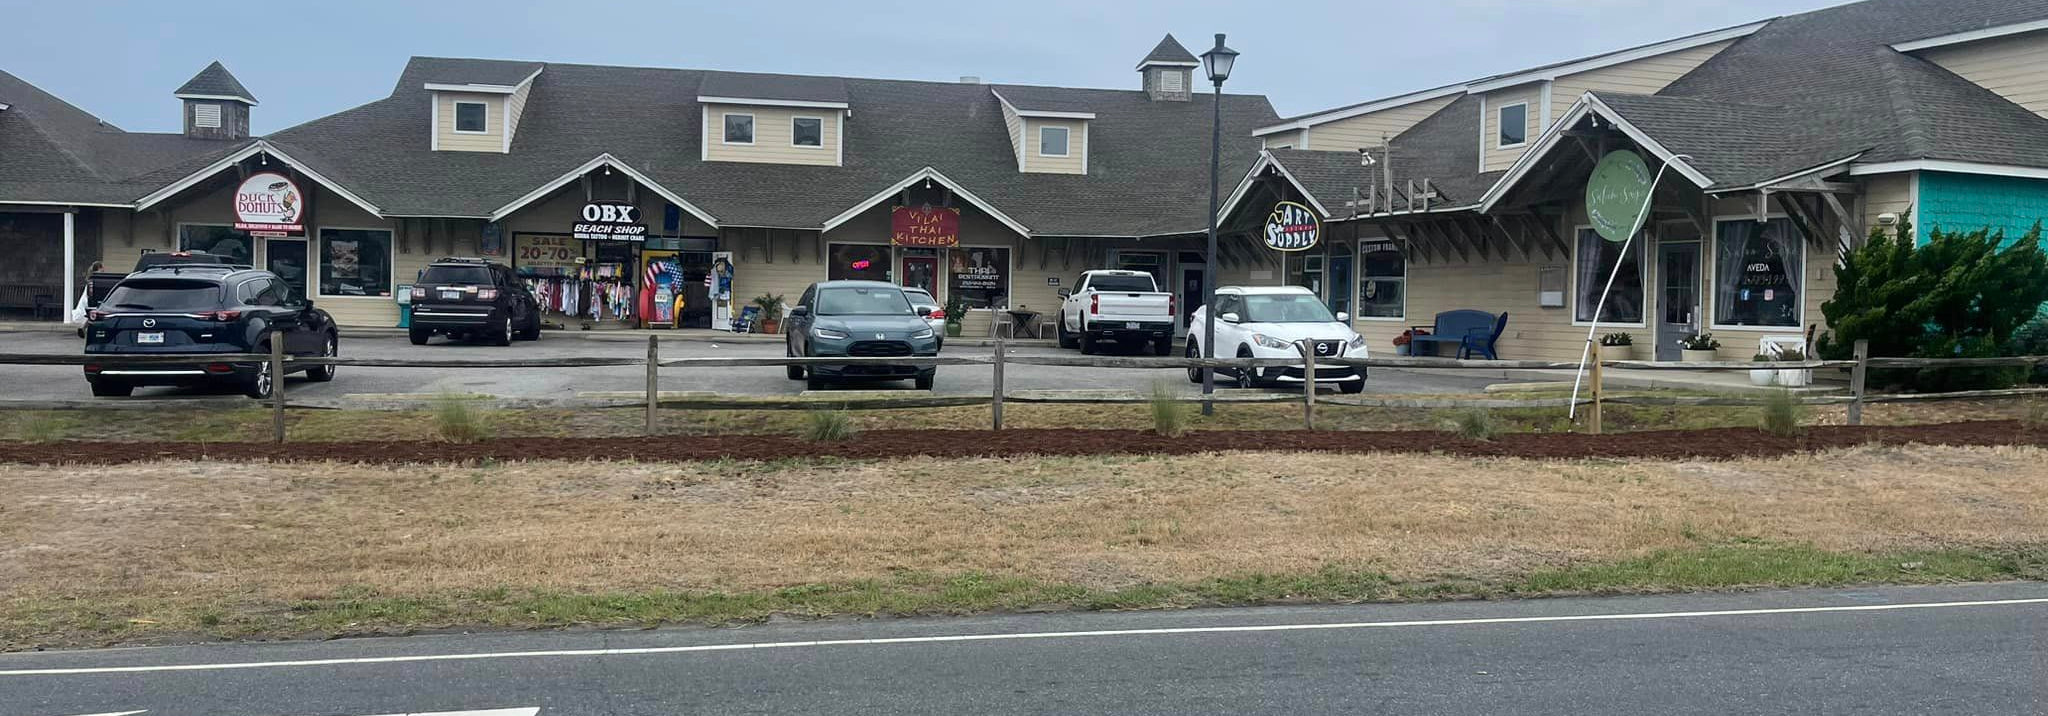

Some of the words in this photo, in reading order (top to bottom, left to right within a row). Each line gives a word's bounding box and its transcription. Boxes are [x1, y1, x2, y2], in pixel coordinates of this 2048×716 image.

[240, 193, 275, 203] DUCK
[239, 201, 283, 214] DONUTS
[583, 204, 634, 223] OBX
[909, 211, 943, 225] VILAI
[1283, 204, 1310, 225] ART
[574, 224, 613, 233] BEACH
[614, 226, 645, 235] SHOP
[909, 225, 941, 235] THAI
[1267, 222, 1316, 248] SUPPLY
[532, 237, 566, 246] SALE
[896, 232, 955, 245] KITCHEN
[1746, 263, 1770, 272] AVEDA
